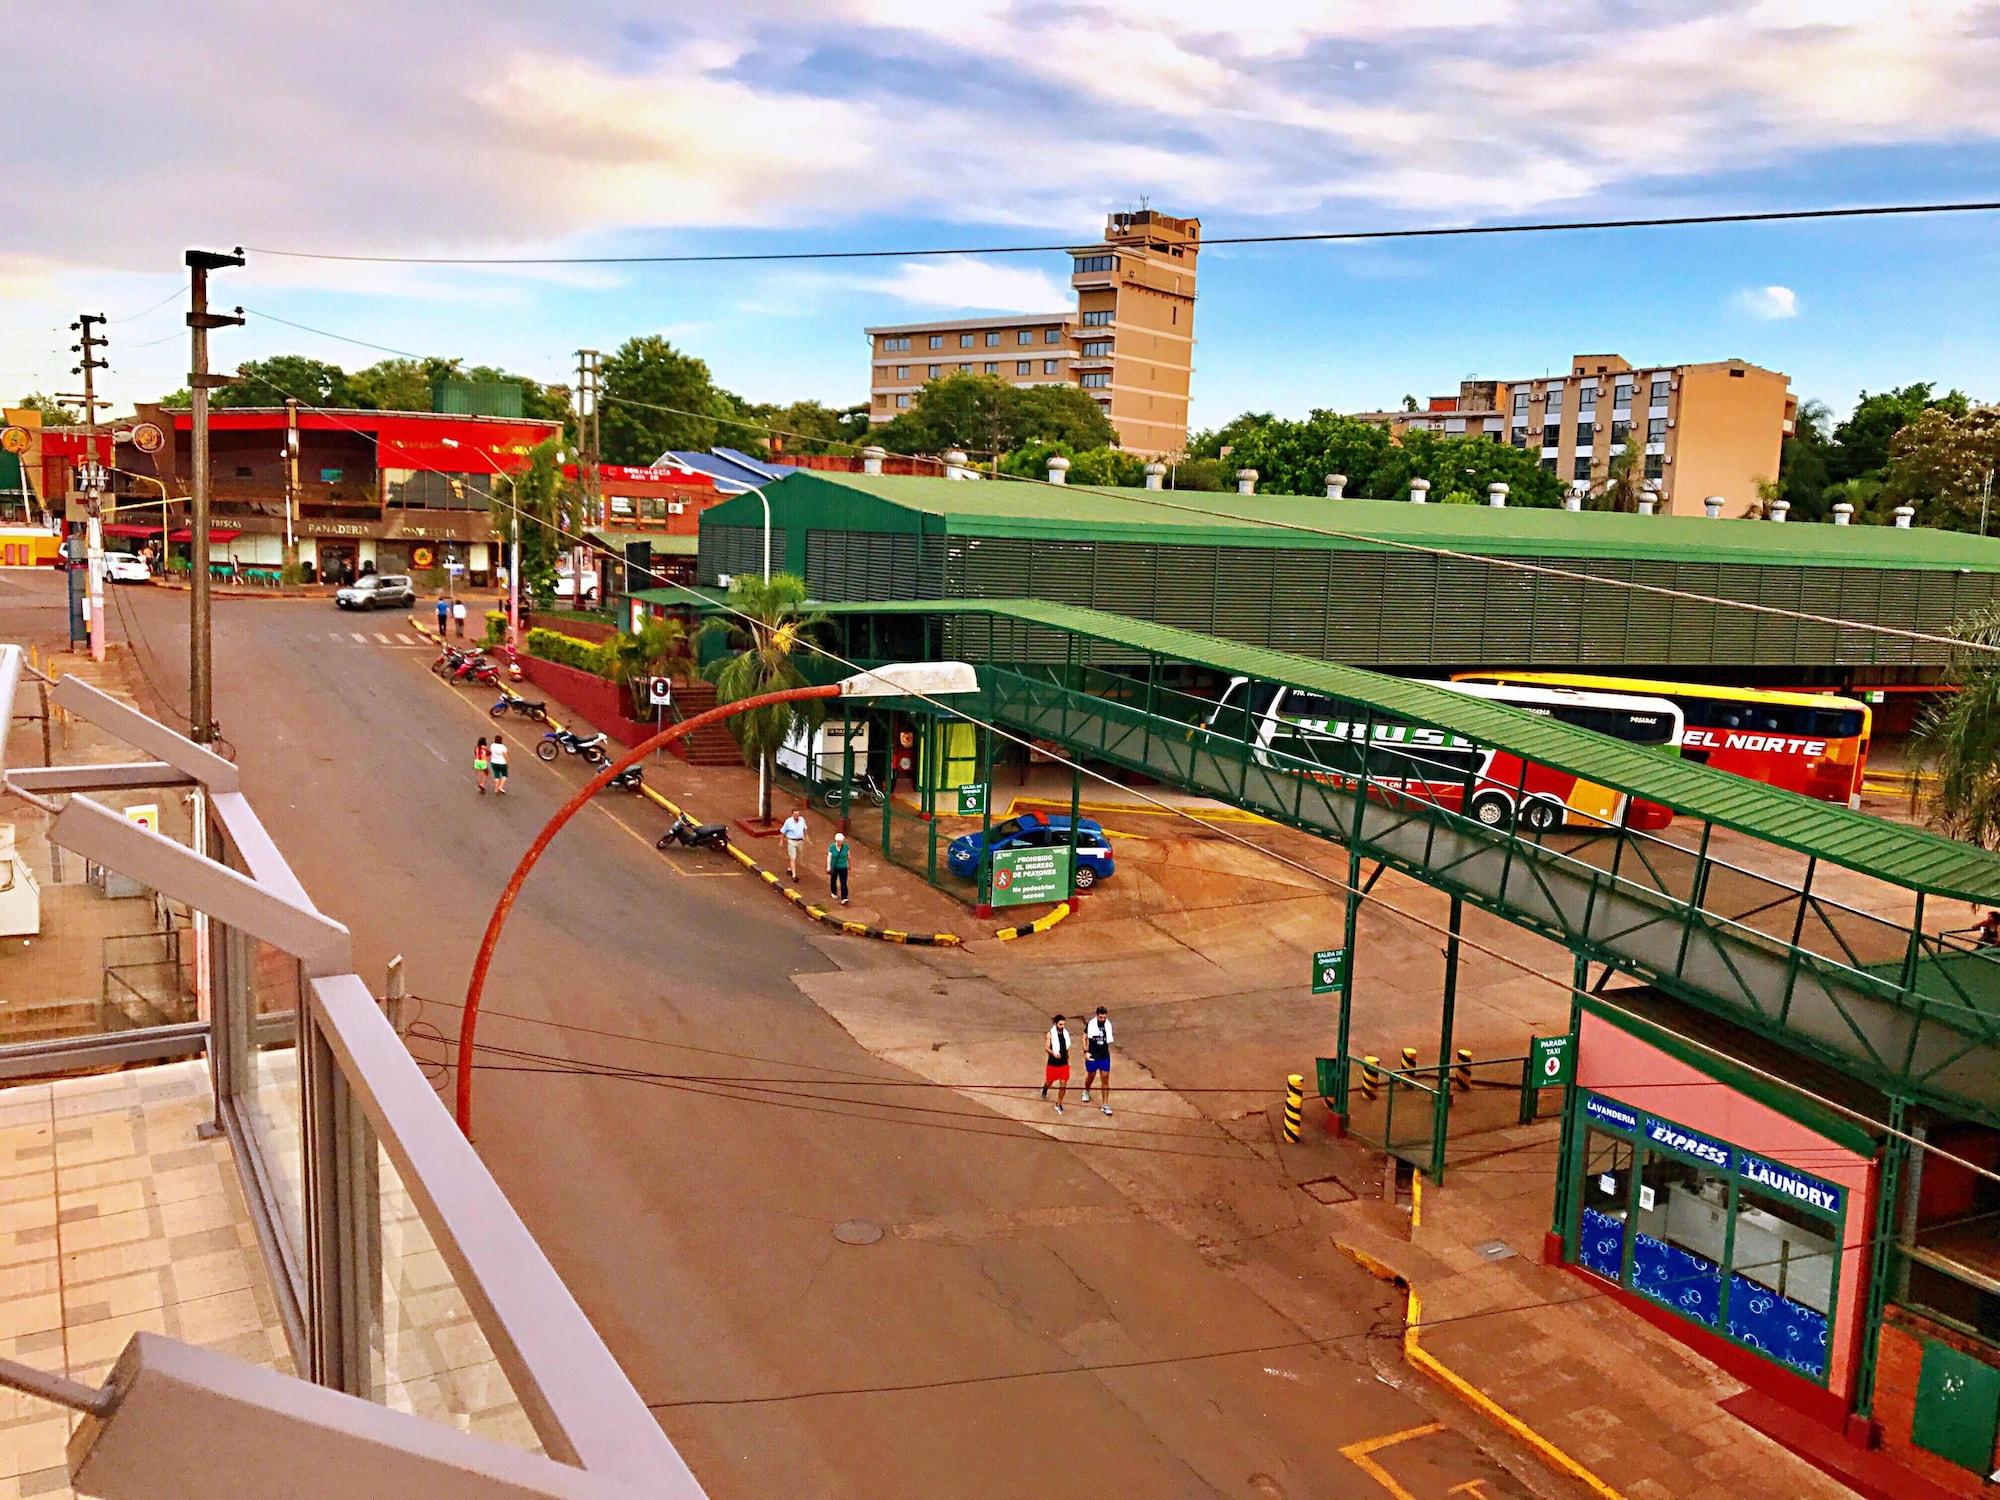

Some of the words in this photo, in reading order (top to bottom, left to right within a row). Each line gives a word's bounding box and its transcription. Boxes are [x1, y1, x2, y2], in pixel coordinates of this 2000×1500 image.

[656, 682, 664, 694] E
[1629, 716, 1657, 725] POSADAS
[1682, 730, 1720, 748] EL
[1724, 734, 1826, 757] NORTE
[1017, 854, 1053, 864] PROHIBIDO
[1025, 862, 1054, 870] INGRESO
[1023, 869, 1057, 878] PEATONES
[1540, 1039, 1567, 1048] PARADA
[1587, 1101, 1636, 1126] LAVANDERIA
[1652, 1127, 1728, 1165] EXPRESS
[1749, 1164, 1835, 1210] LAUNDRY
